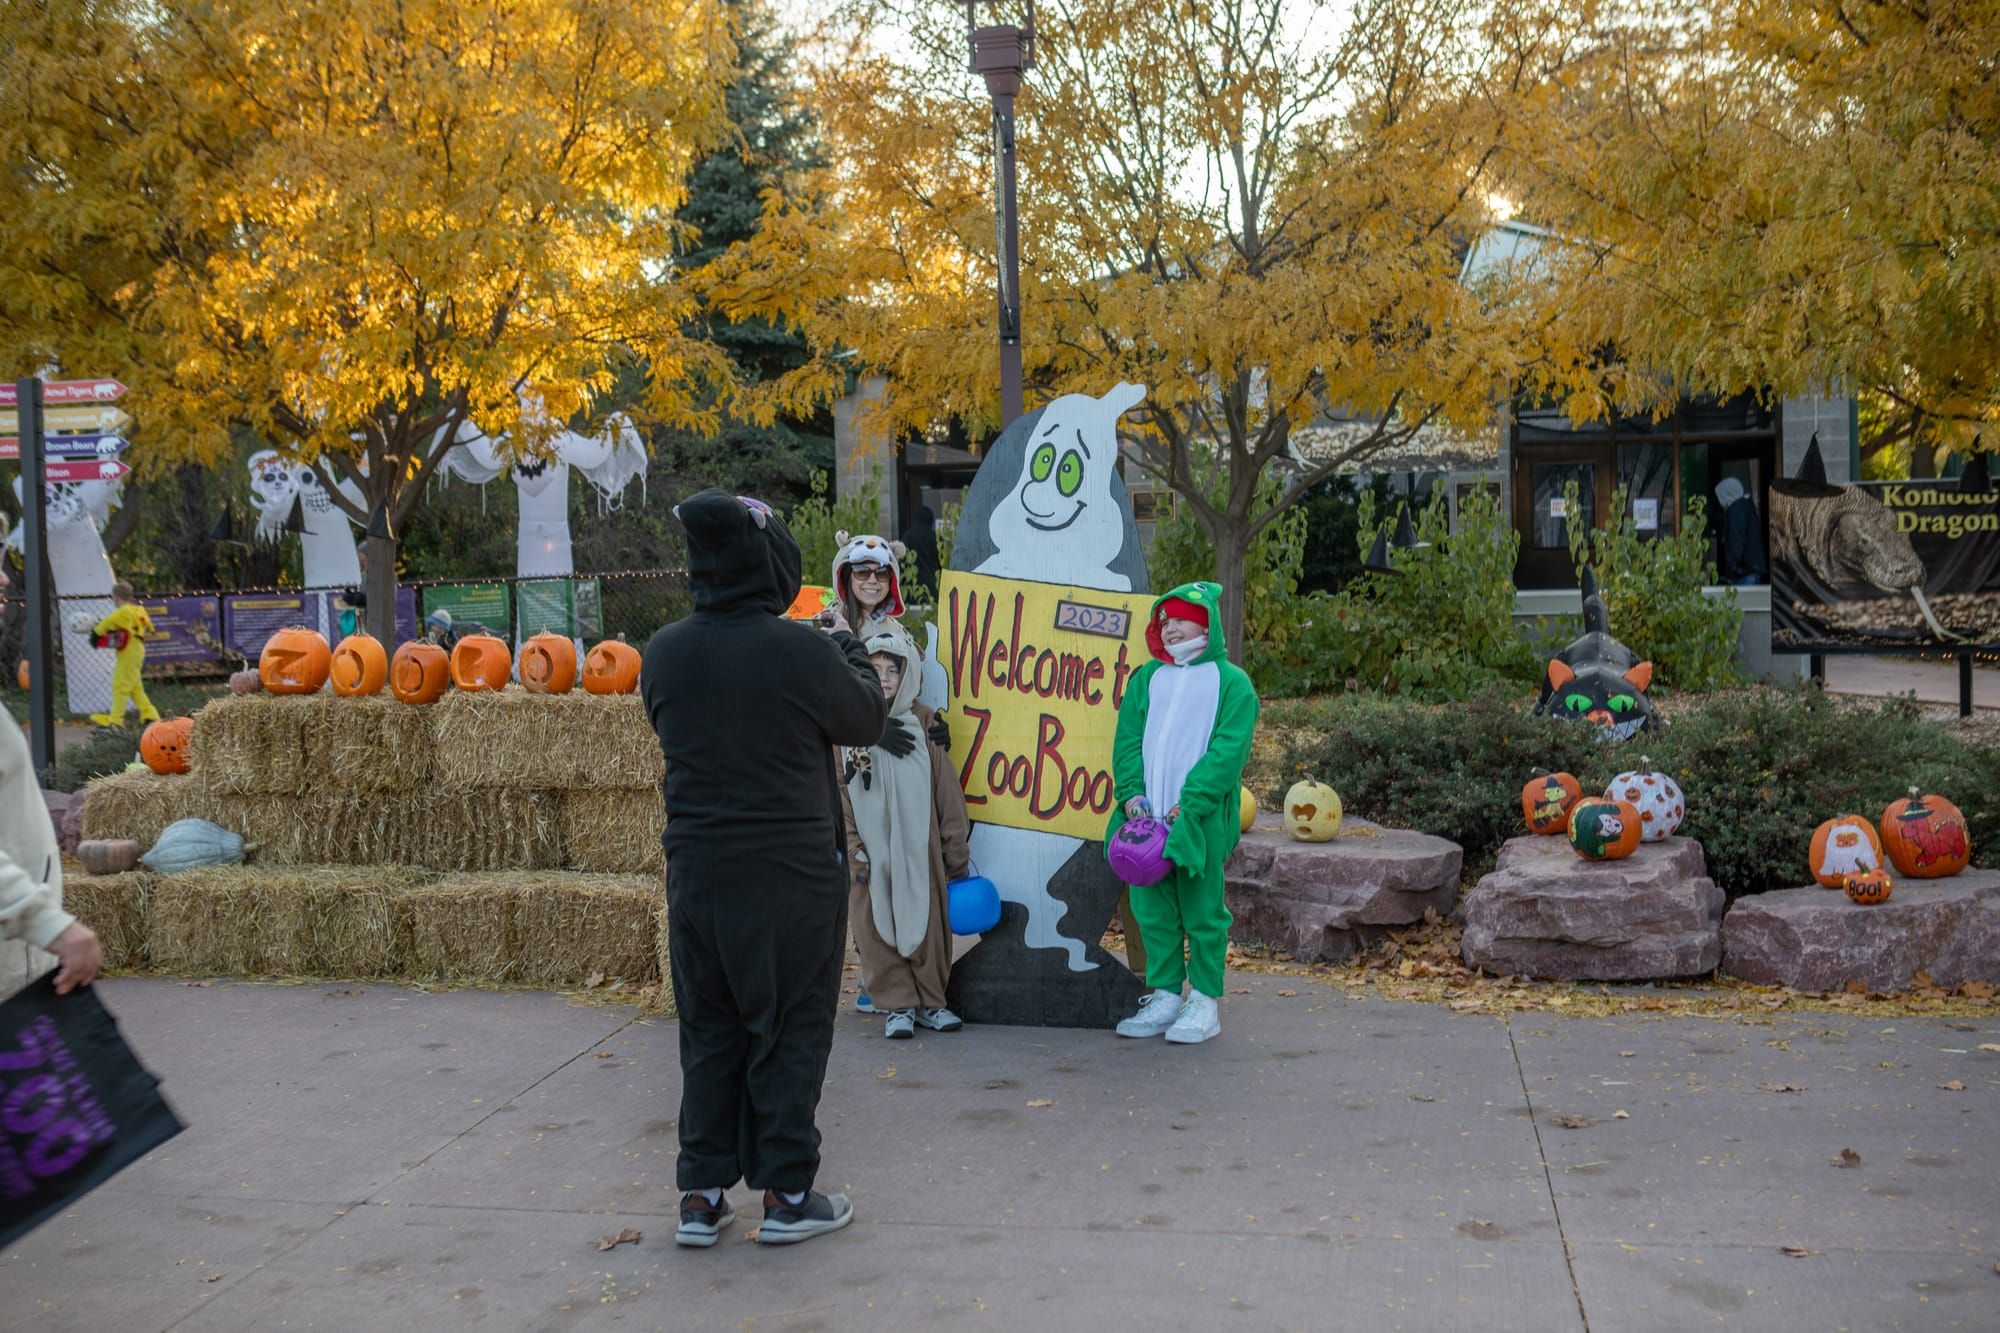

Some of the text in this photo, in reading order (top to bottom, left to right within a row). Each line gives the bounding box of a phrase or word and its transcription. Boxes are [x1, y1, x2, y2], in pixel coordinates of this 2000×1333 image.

[67, 386, 93, 399] Tigers
[45, 440, 95, 451] Brown Bears
[46, 467, 70, 478] Bison
[1897, 511, 2000, 539] Dragon
[1062, 606, 1121, 633] 2023
[949, 586, 1105, 706] Welcome
[959, 704, 1114, 821] ZooBoo
